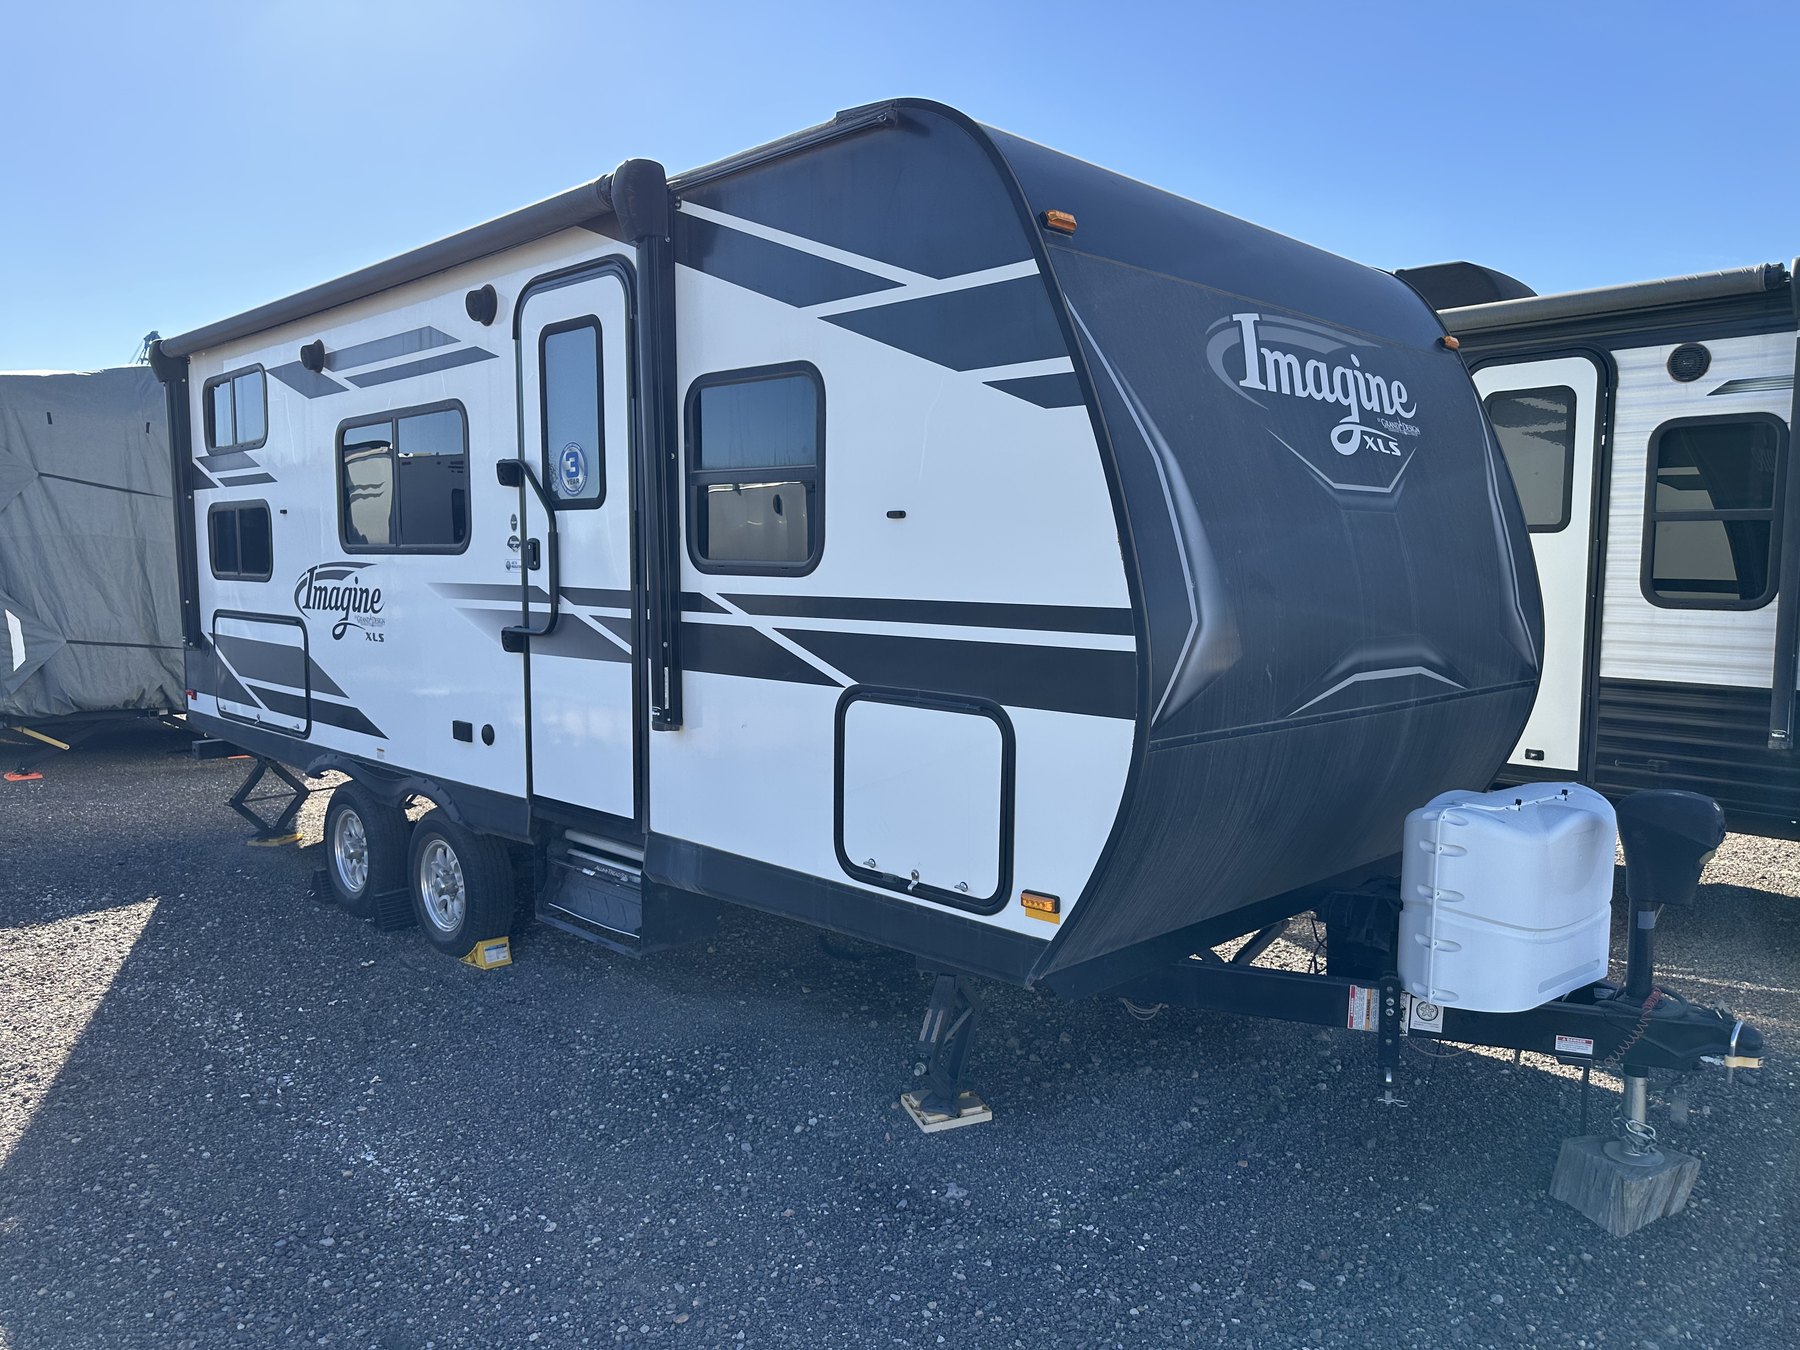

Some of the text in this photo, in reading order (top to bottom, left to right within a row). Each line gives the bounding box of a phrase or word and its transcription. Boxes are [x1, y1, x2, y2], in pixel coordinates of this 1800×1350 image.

[1232, 313, 1417, 456] Imagine
[1362, 434, 1401, 456] XLS
[565, 451, 580, 479] 3
[567, 478, 580, 486] YEAR
[302, 565, 386, 640] Imagine
[365, 632, 385, 642] XLS
